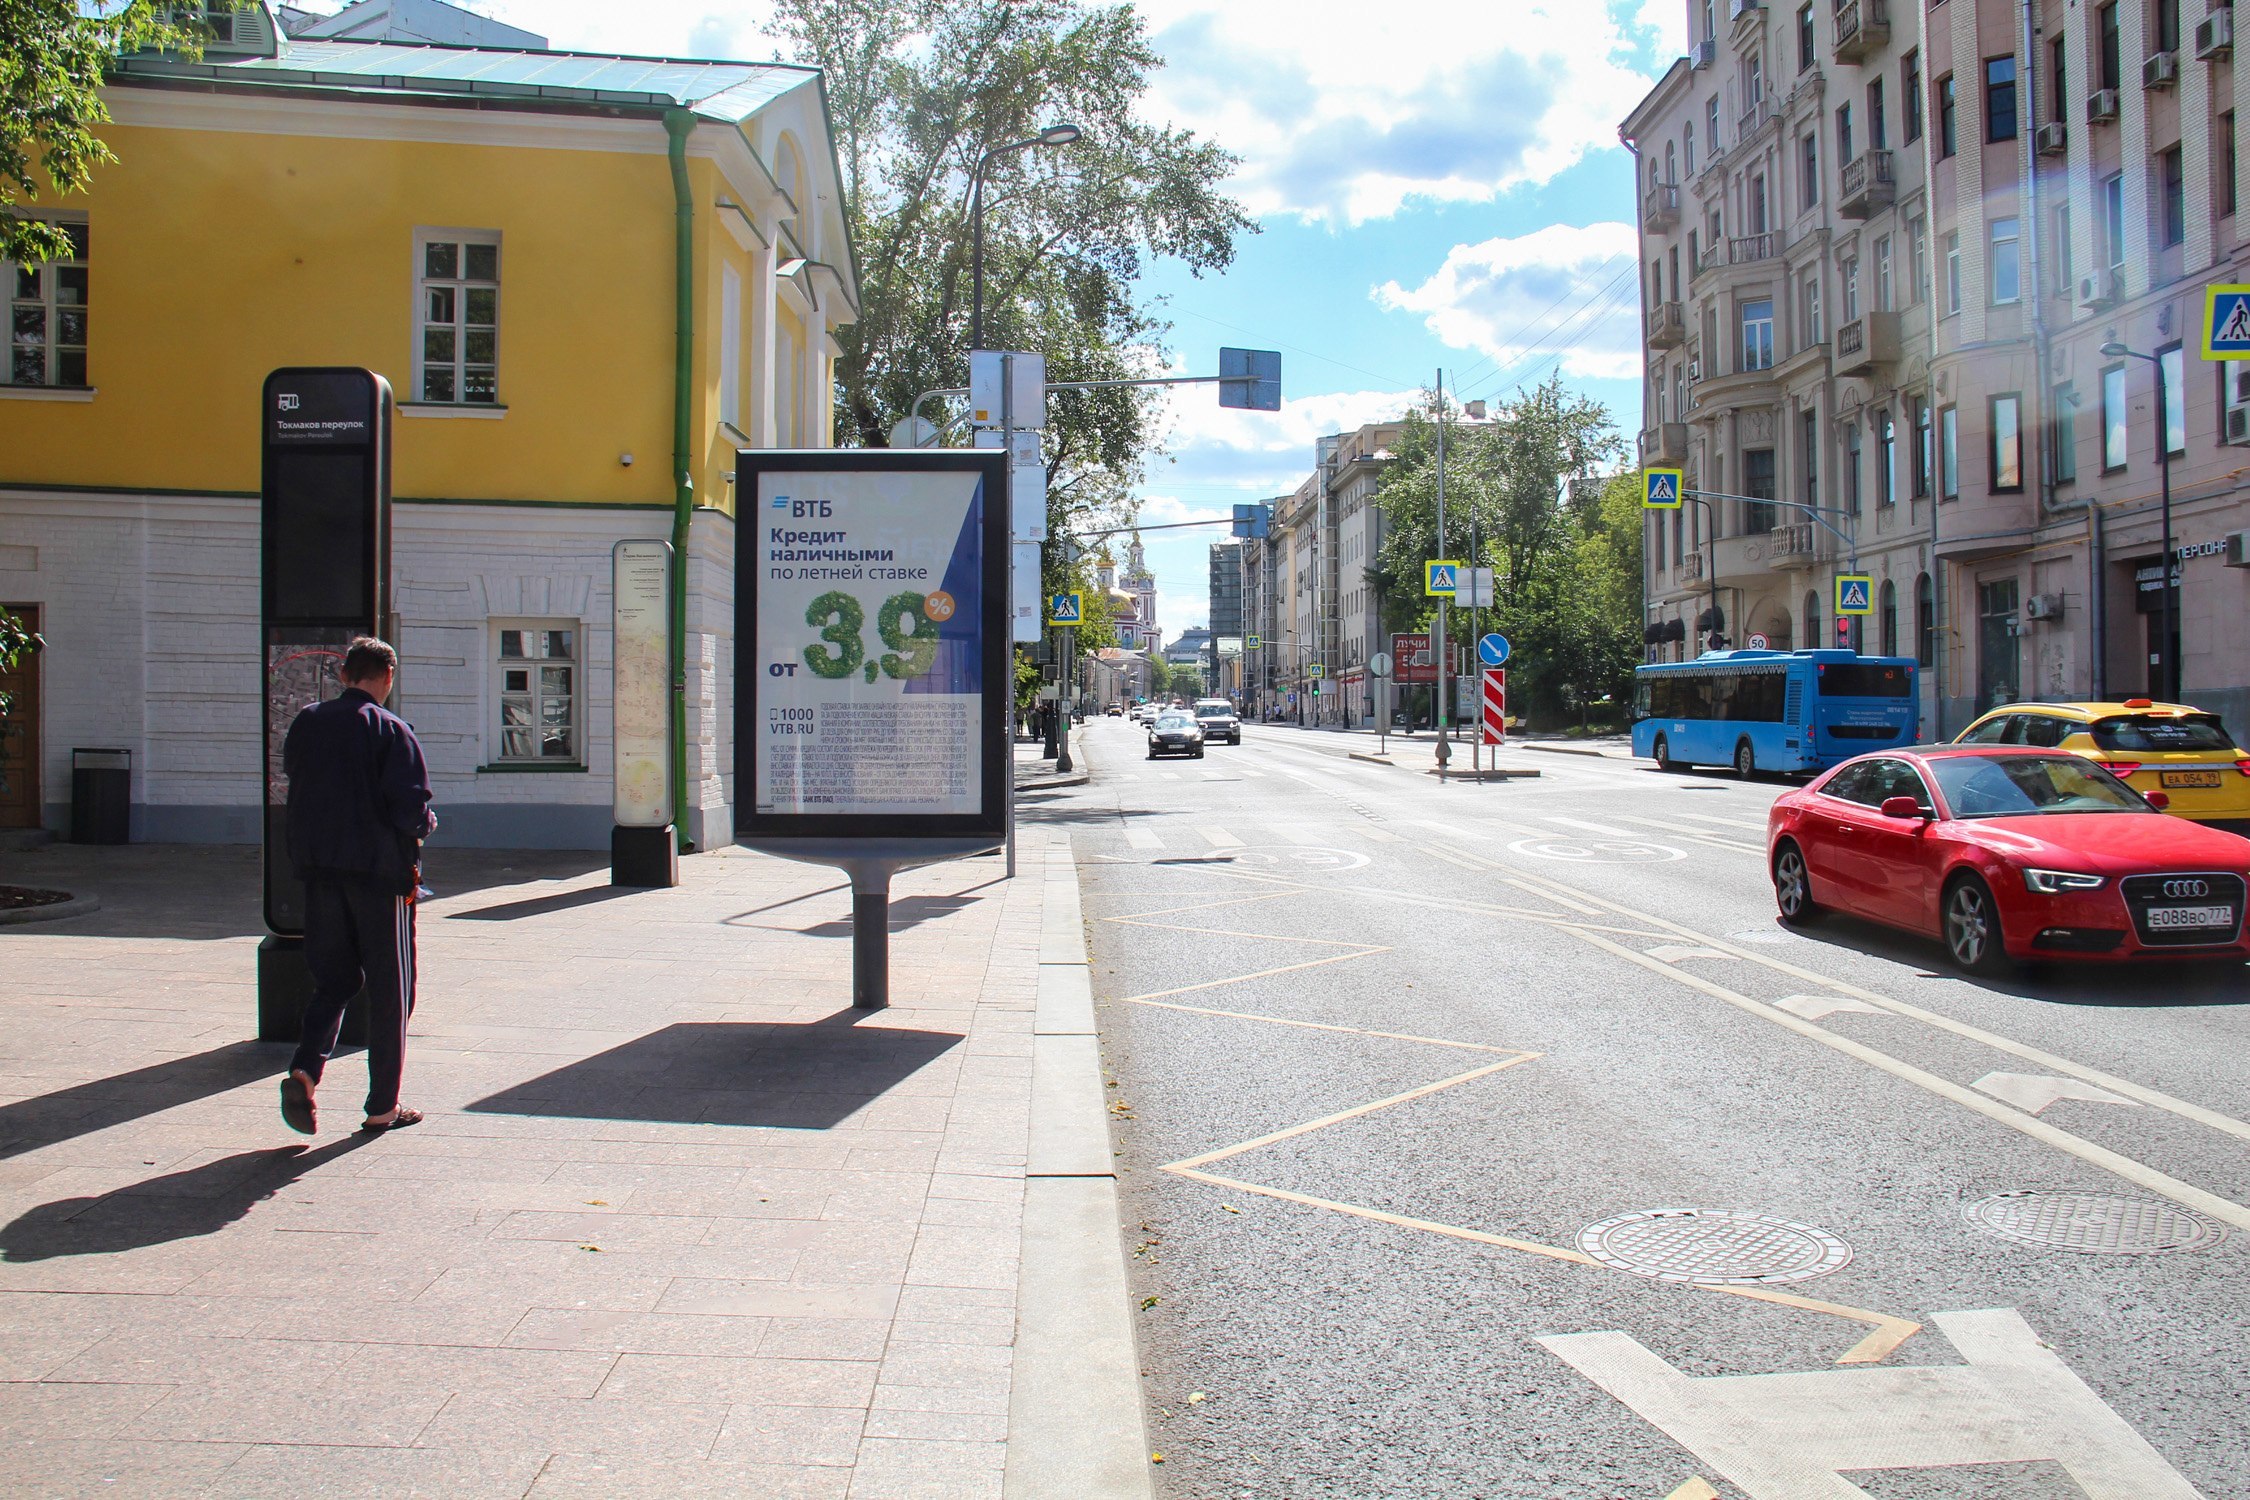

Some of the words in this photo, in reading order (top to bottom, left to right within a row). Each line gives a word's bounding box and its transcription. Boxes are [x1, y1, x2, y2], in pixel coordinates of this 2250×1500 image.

[277, 420, 320, 430] Токмаков
[321, 420, 364, 430] переулок
[792, 500, 832, 518] ВТБ
[770, 528, 846, 546] Кредит
[770, 549, 893, 562] наличными
[770, 566, 793, 580] по
[798, 563, 863, 580] летней
[868, 566, 928, 580] ставке
[769, 663, 798, 677] от
[803, 590, 941, 684] 3,9
[1751, 639, 1764, 648] 50
[781, 708, 814, 721] 1000
[770, 723, 814, 735] VTB.RU
[2183, 773, 2203, 783] 054
[2152, 909, 2206, 925] Е088ВО
[2208, 907, 2227, 919] 777
